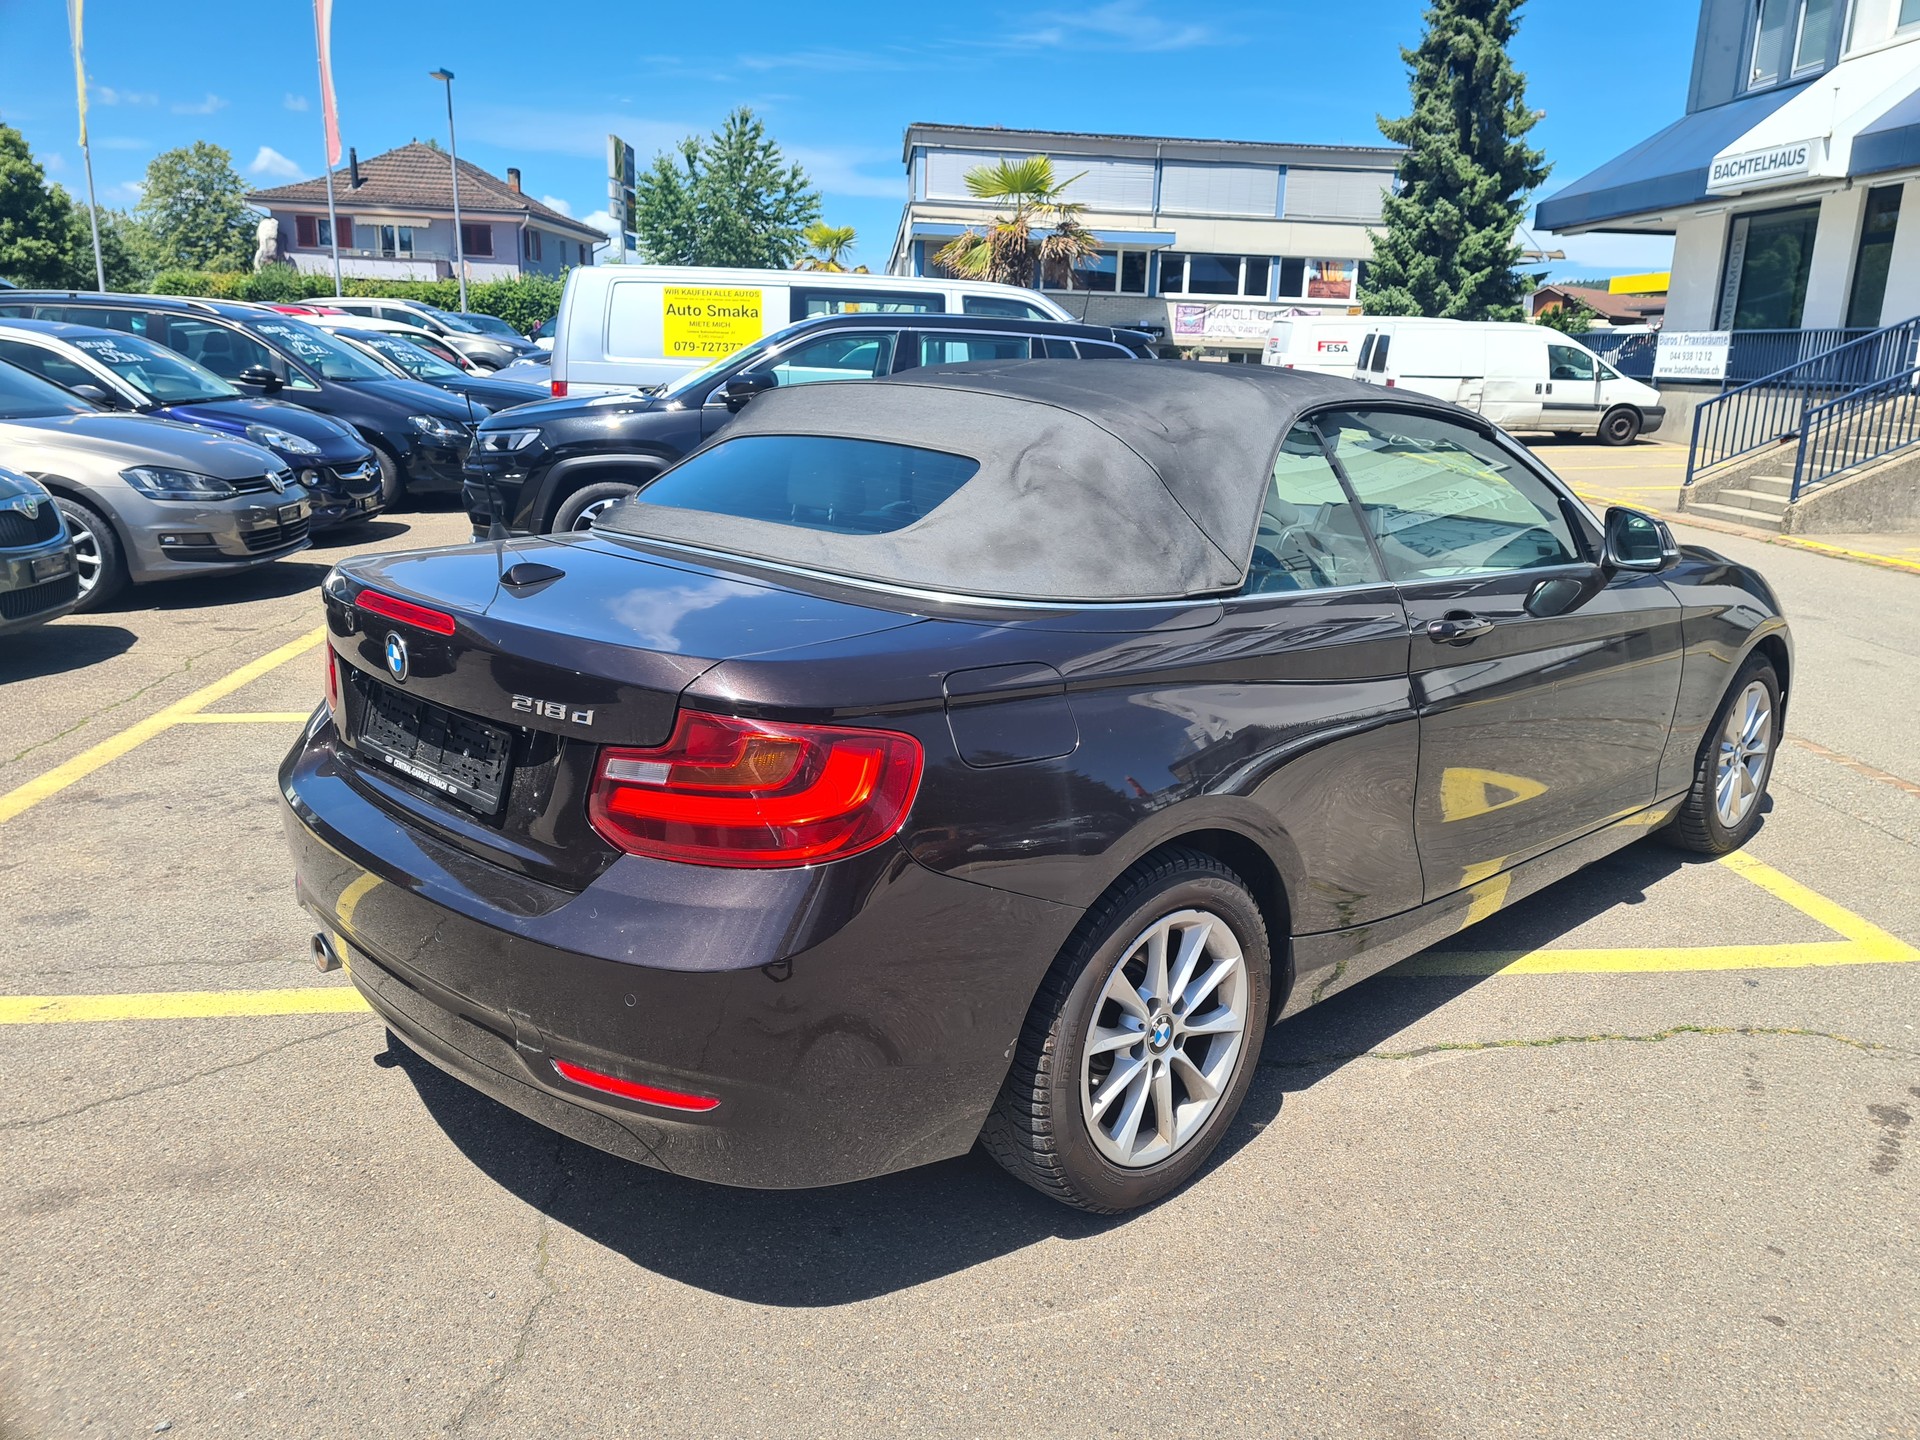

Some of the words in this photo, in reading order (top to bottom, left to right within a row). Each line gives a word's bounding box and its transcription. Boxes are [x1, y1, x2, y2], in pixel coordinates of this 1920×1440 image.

[1713, 147, 1806, 181] BACHTELHAUS
[1721, 231, 1745, 331] AMENMODE
[665, 288, 680, 296] WIR
[681, 288, 712, 297] KAUFEN
[714, 290, 732, 298] ALLE
[734, 290, 760, 298] AUTOS
[666, 303, 702, 317] Auto
[707, 304, 759, 318] Smaka
[689, 320, 710, 328] MIETE
[1659, 334, 1678, 346] Büros
[1684, 333, 1728, 346] Praxisräume
[1318, 341, 1349, 353] FESA
[1669, 351, 1681, 361] 044
[1682, 351, 1693, 361] 938
[1695, 351, 1703, 361] 12
[1705, 351, 1713, 361] 12
[1658, 364, 1720, 376] www.bachtelhaus.ch
[511, 693, 567, 721] 218
[571, 709, 595, 726] d
